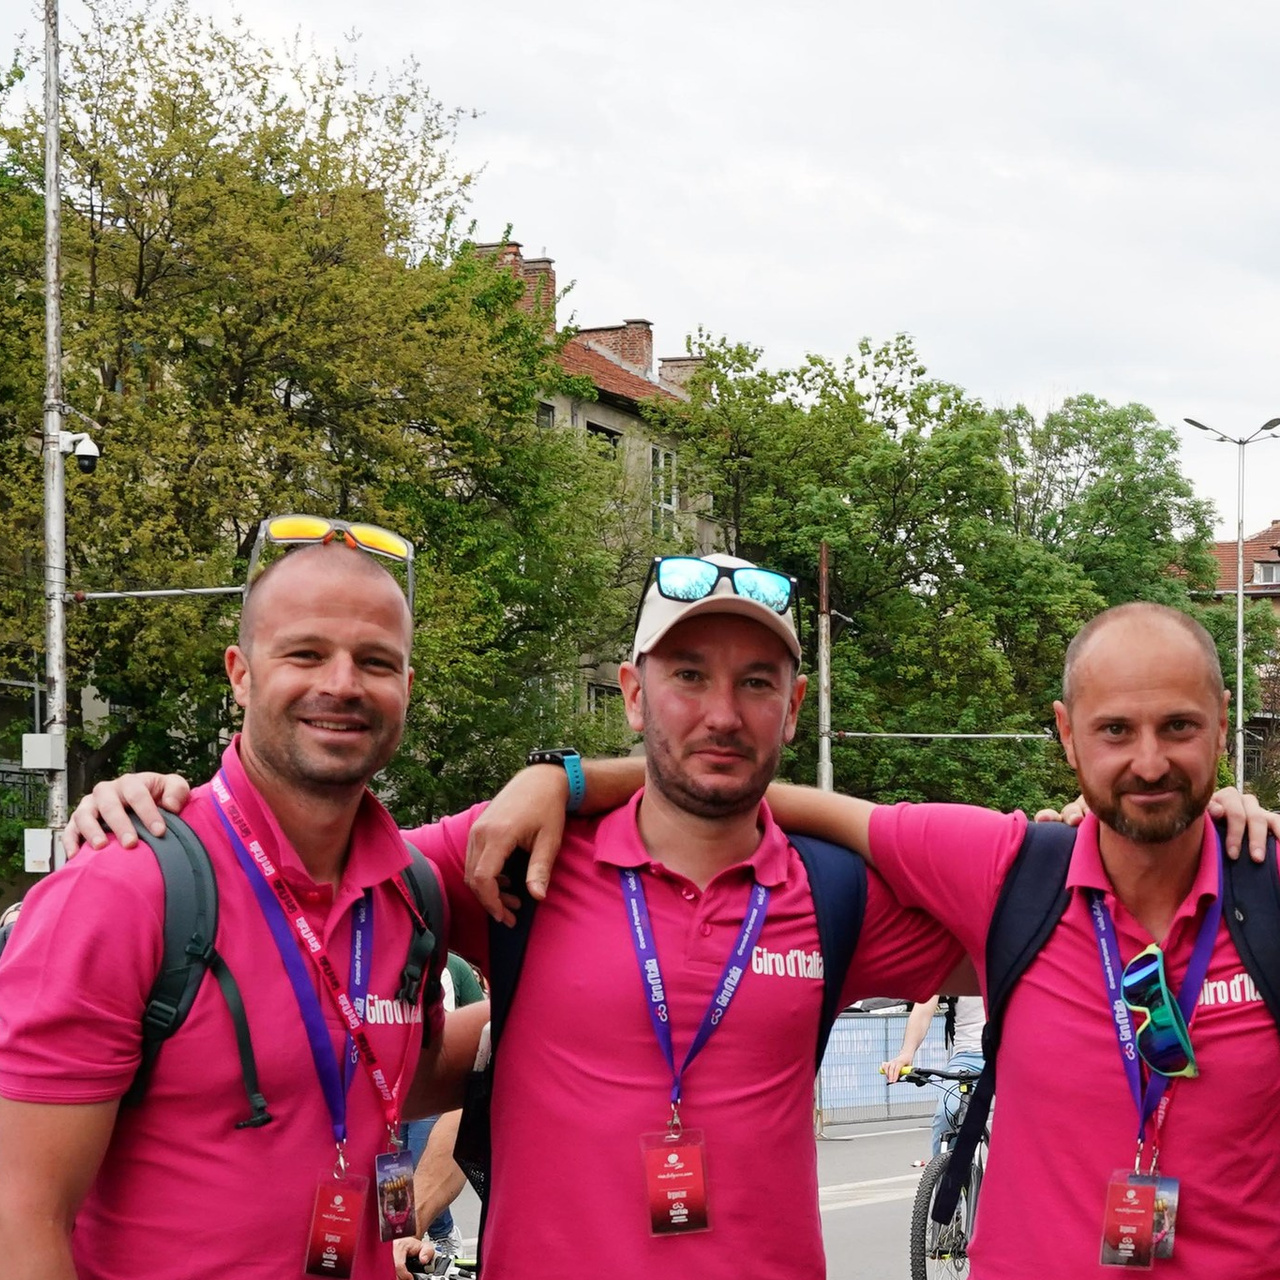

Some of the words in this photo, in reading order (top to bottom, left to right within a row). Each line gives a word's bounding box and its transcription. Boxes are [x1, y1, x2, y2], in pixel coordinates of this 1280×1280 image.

[751, 945, 786, 977] Giro
[652, 984, 664, 1002] Giro
[1229, 973, 1263, 1002] d'It
[716, 989, 732, 1007] Giro
[1119, 1024, 1132, 1041] Giro
